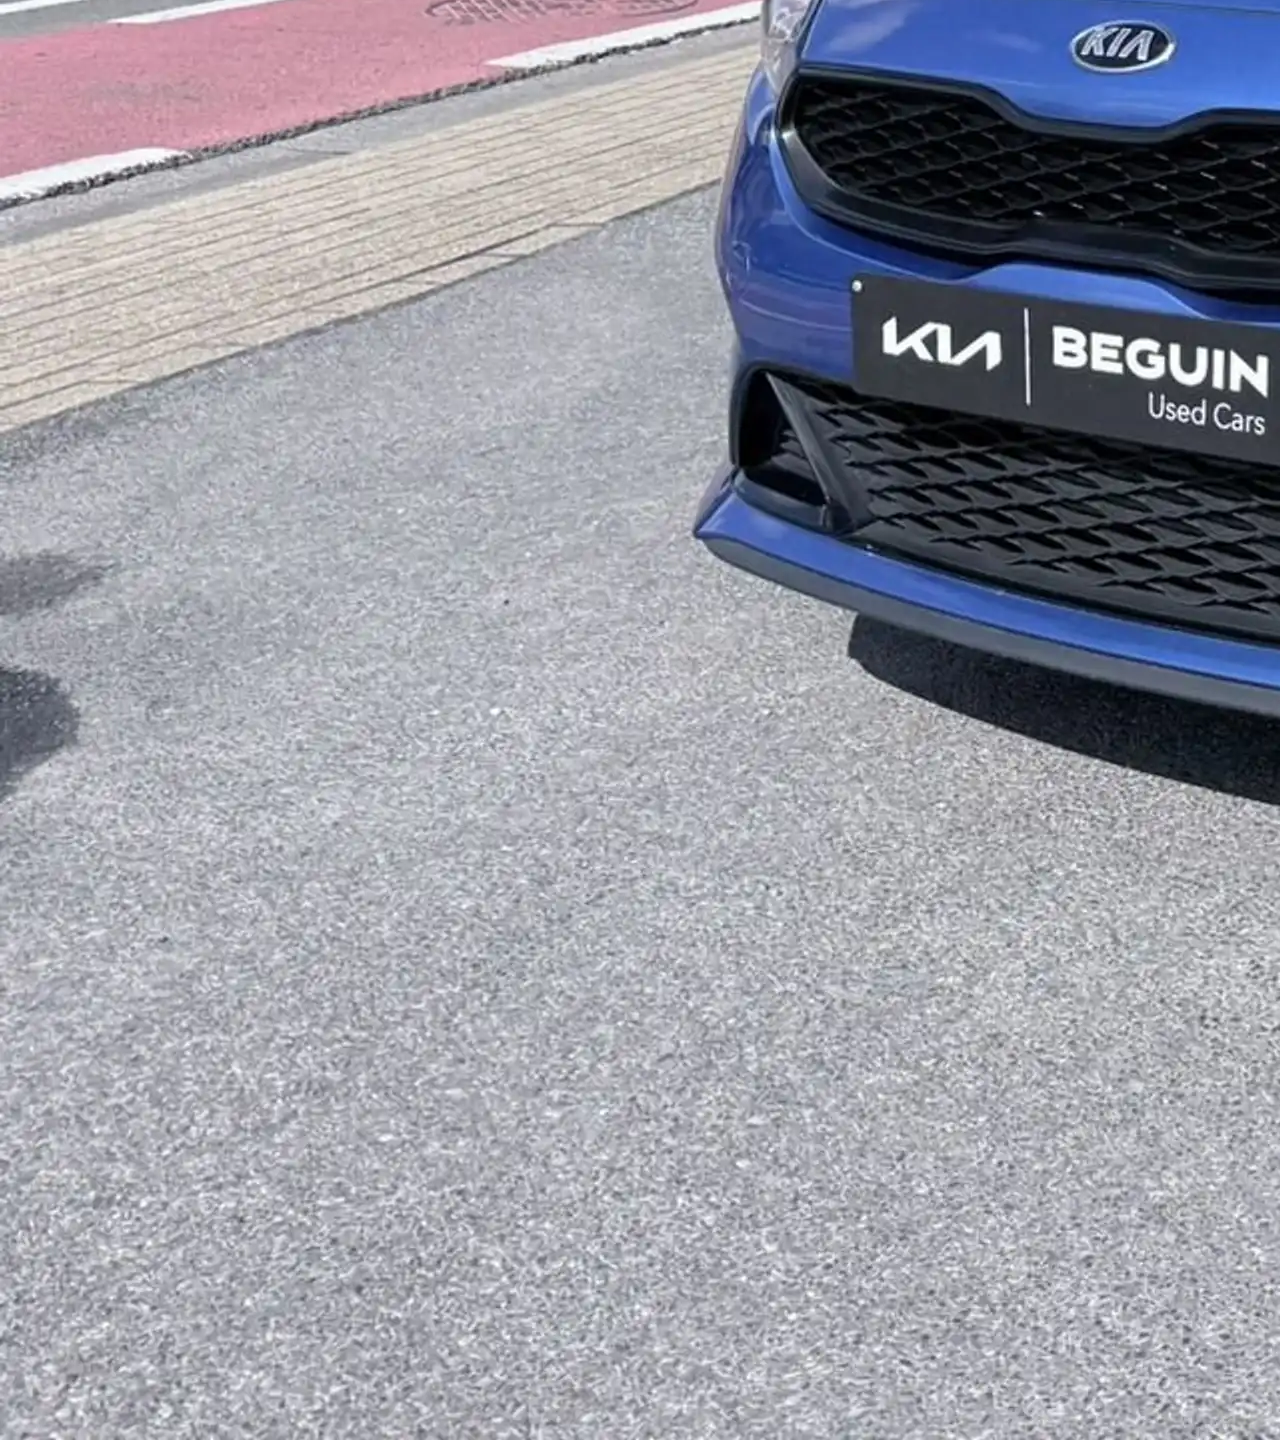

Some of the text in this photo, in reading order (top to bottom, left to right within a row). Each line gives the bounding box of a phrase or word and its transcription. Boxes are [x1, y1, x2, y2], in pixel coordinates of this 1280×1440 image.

[1080, 26, 1155, 62] KIA
[881, 315, 1270, 399] KIA BEGUIN
[1147, 391, 1266, 436] Used Cars
